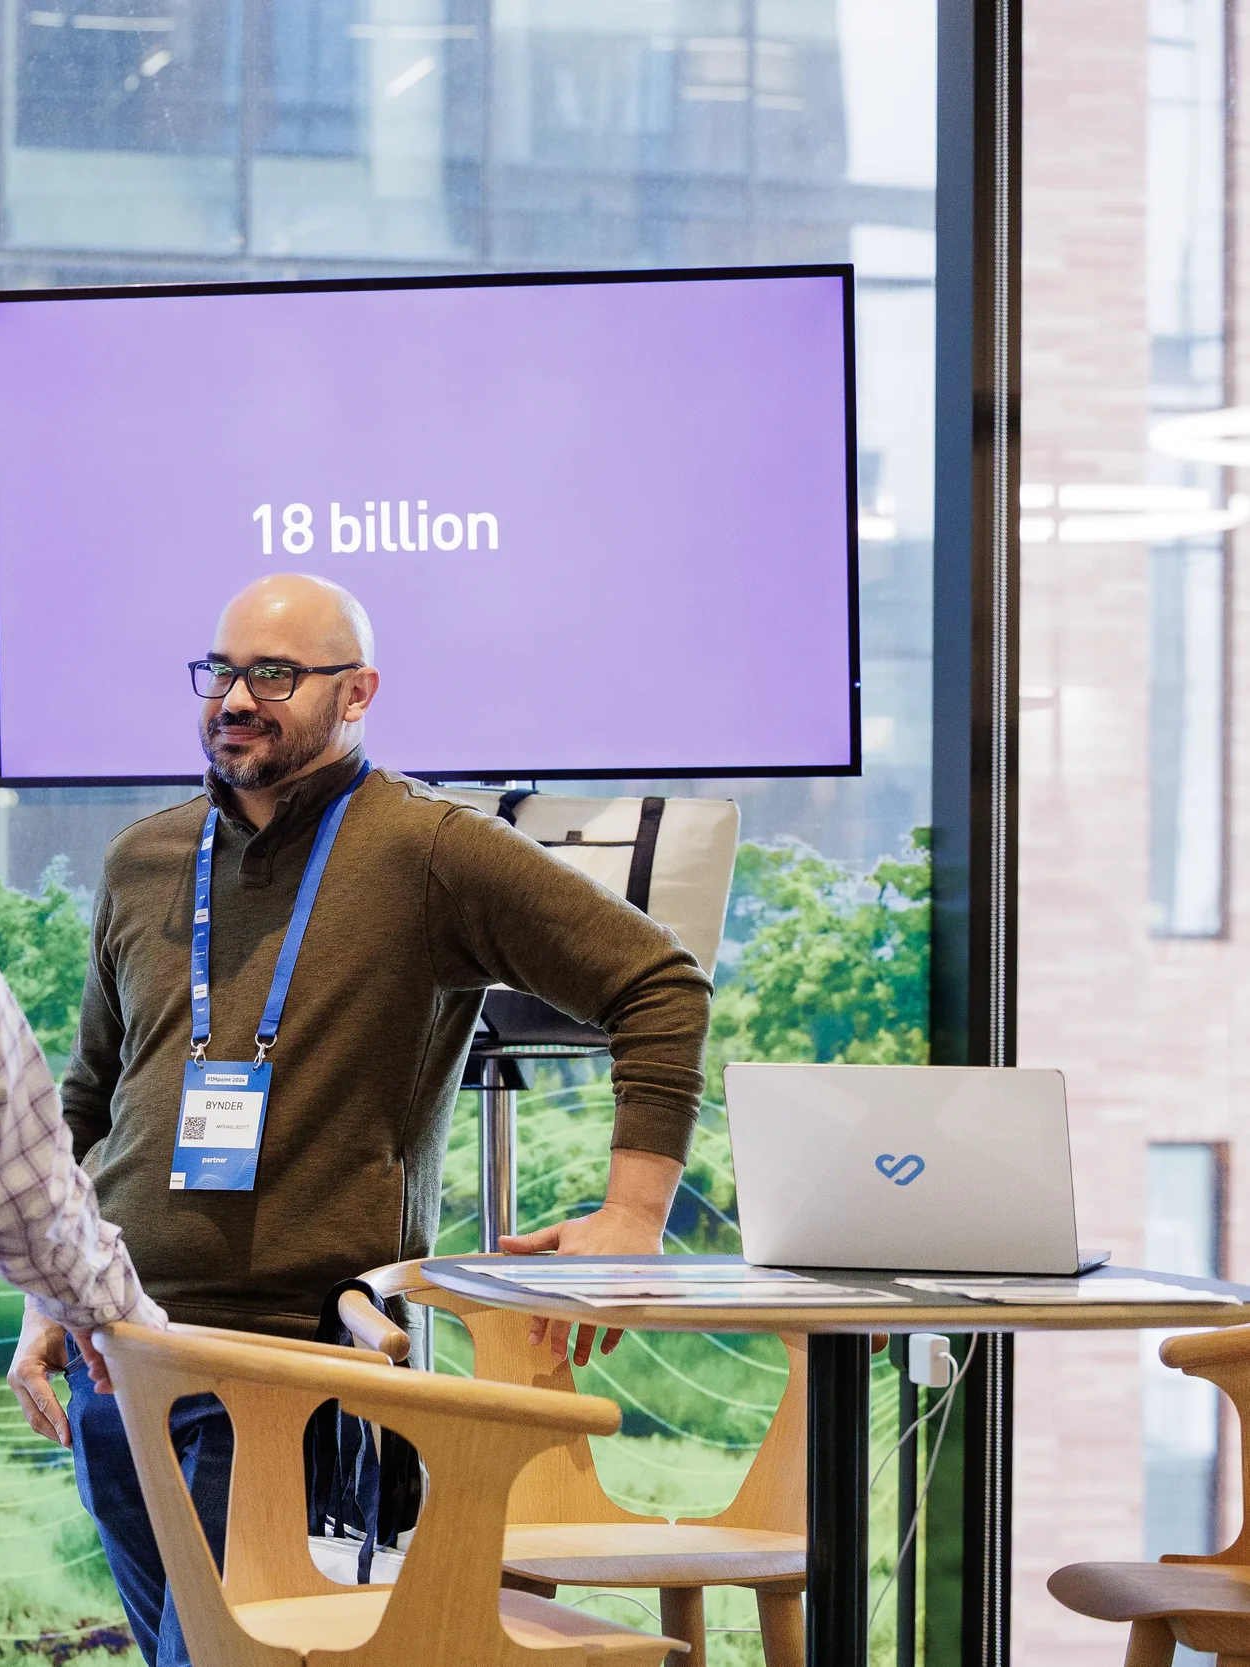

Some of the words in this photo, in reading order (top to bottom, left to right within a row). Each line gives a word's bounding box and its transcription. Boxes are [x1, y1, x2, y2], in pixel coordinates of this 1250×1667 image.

[252, 502, 315, 555] 18
[330, 500, 499, 554] billion
[206, 1100, 243, 1110] BYNDER
[202, 1157, 228, 1165] partner
